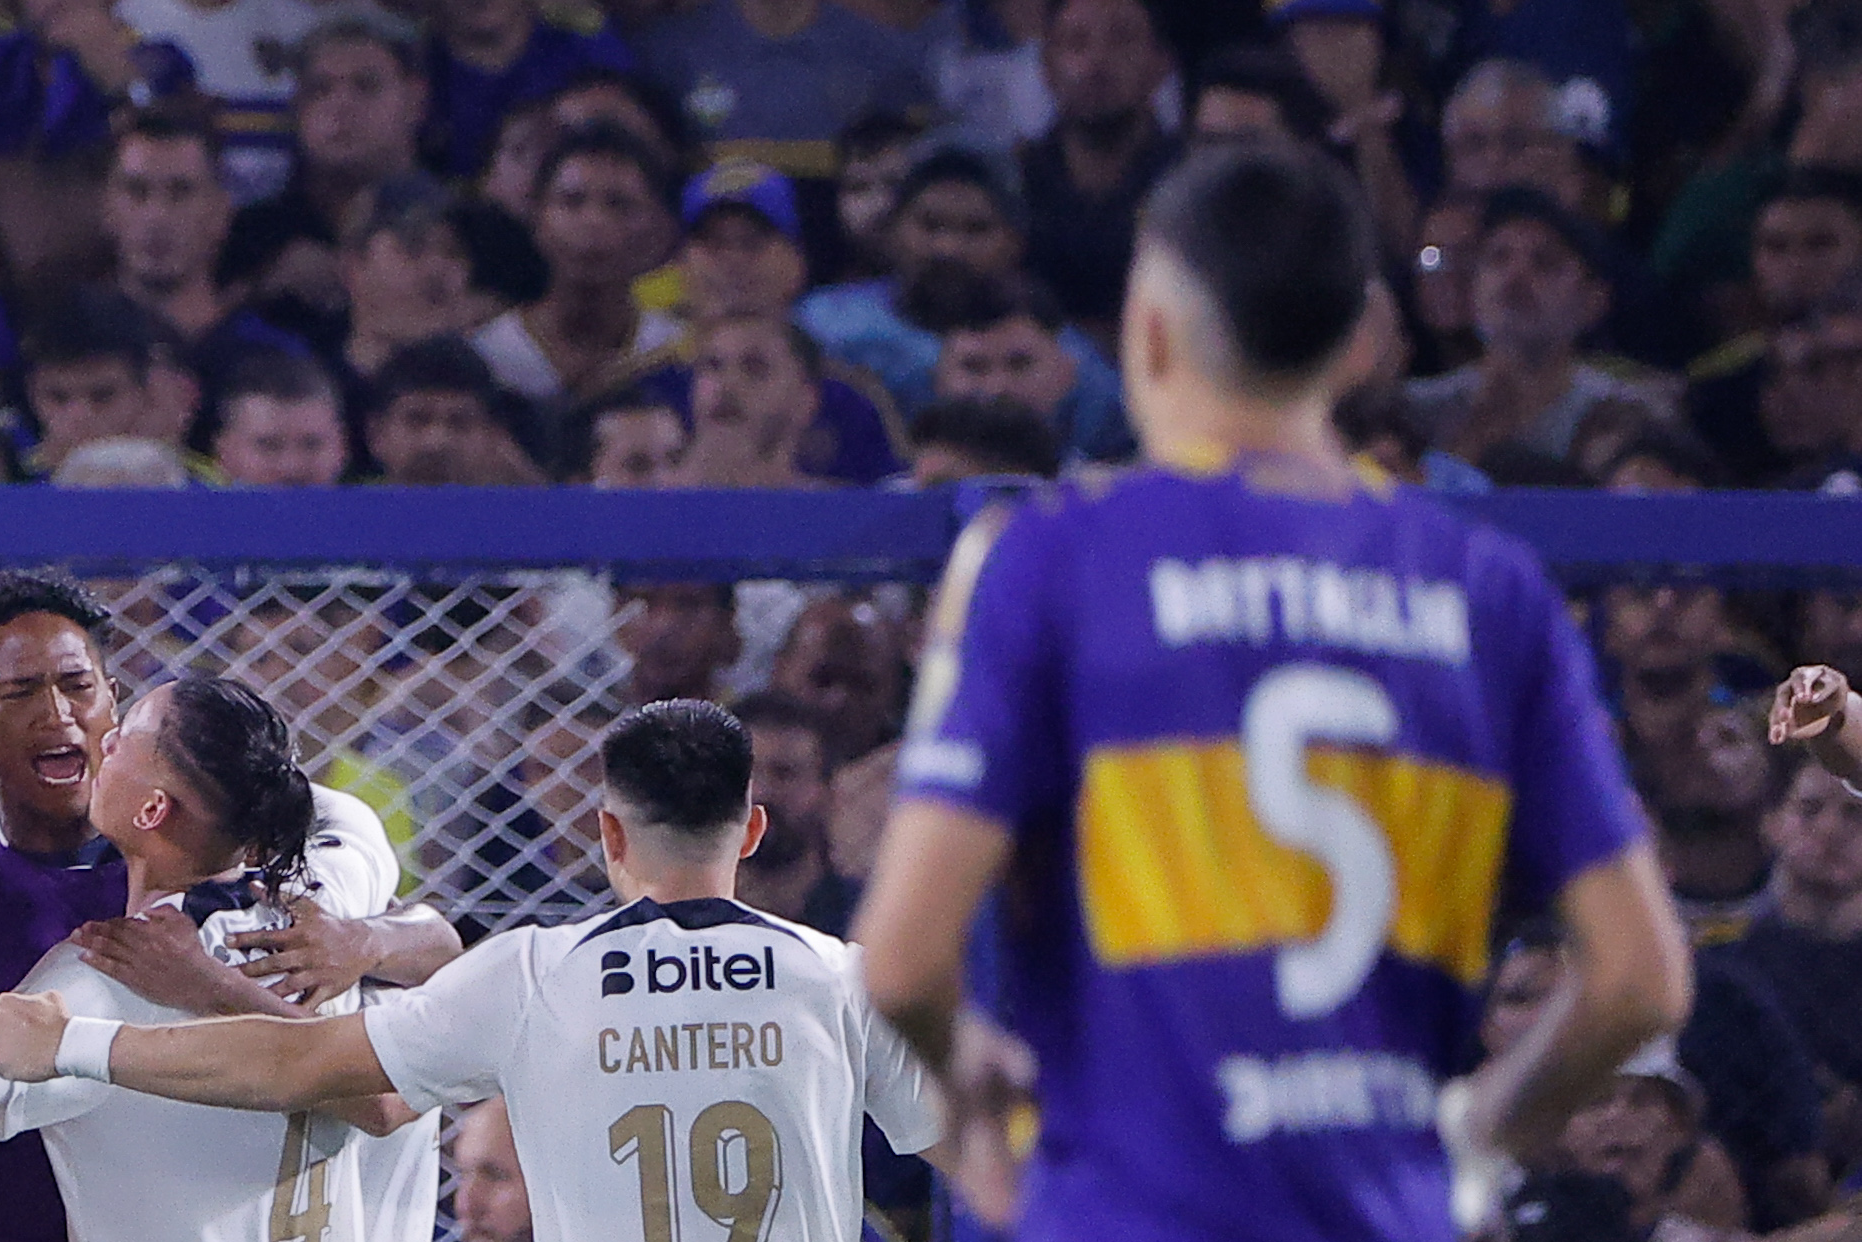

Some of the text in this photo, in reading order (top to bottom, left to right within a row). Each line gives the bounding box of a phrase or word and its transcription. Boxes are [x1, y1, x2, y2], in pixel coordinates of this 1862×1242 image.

[1243, 661, 1400, 1020] 5
[647, 946, 775, 994] bitel
[599, 1021, 783, 1074] CANTERO
